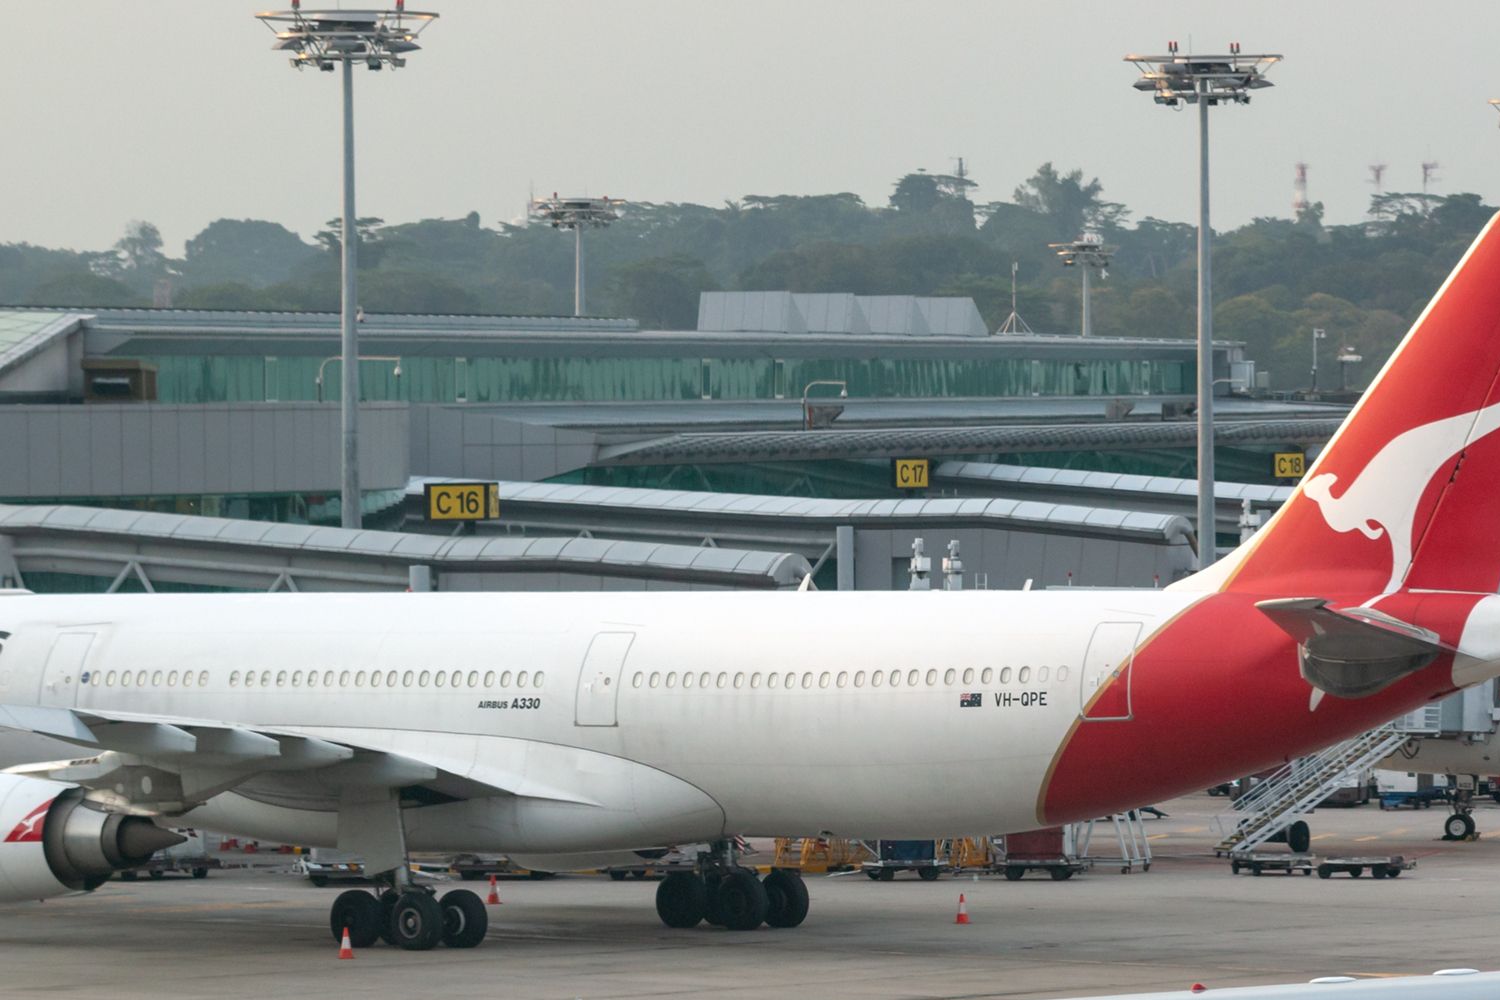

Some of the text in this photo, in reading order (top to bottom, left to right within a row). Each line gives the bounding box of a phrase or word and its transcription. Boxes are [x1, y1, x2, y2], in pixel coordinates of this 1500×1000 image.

[478, 697, 541, 709] AIRBUS A330
[994, 691, 1048, 707] VH-QPE
